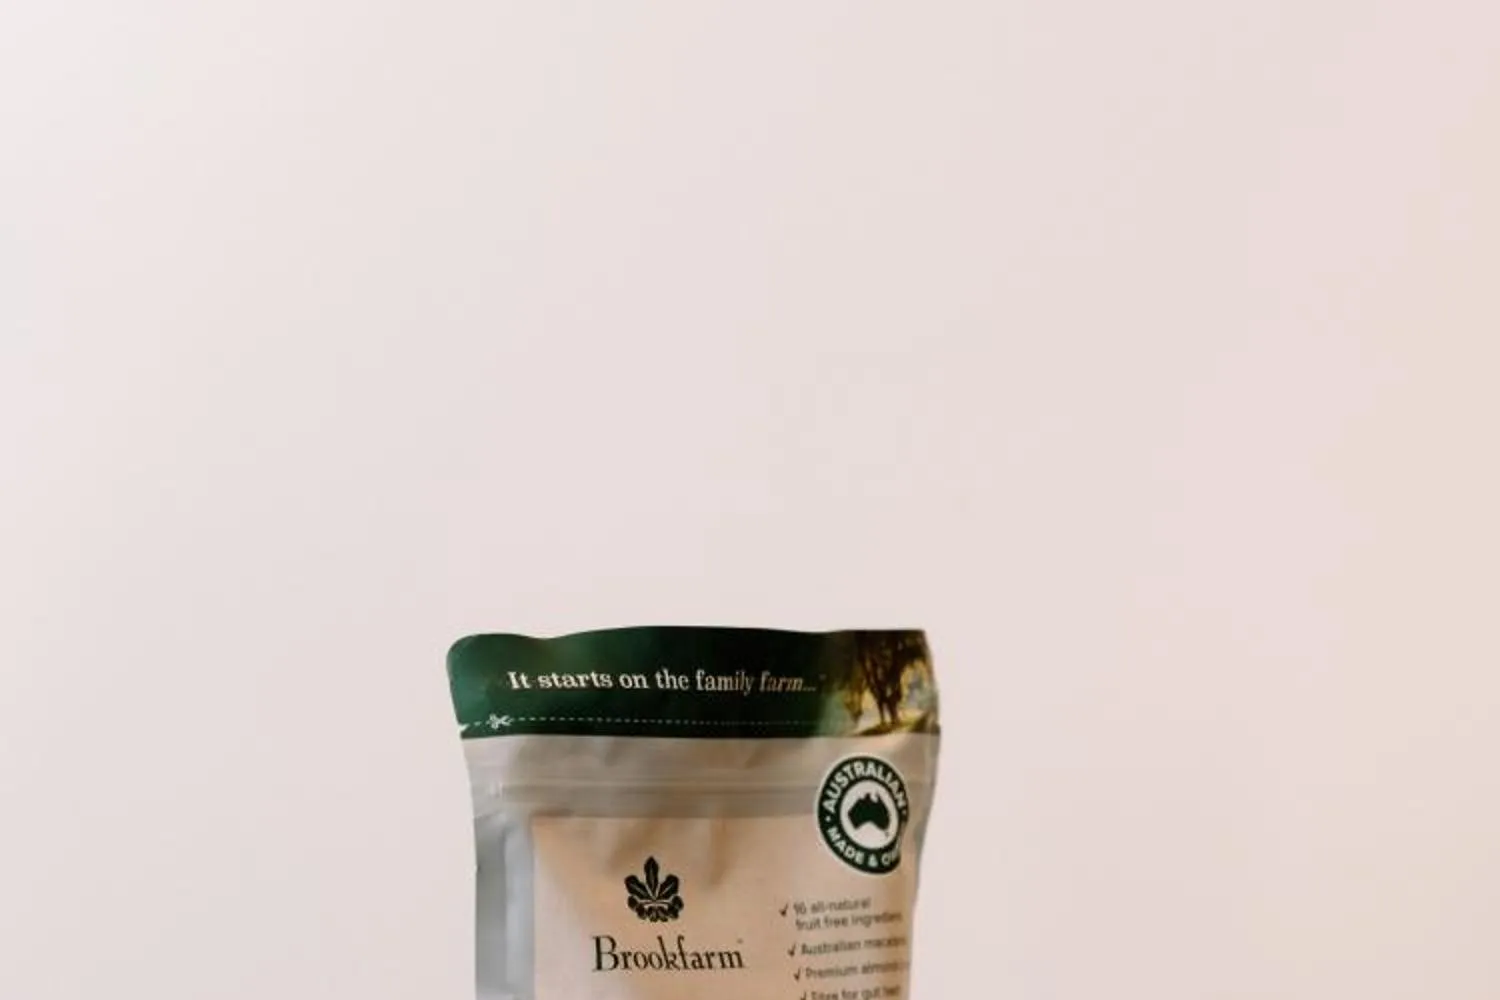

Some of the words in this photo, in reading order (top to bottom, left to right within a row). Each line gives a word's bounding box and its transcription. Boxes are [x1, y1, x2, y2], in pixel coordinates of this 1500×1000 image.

[507, 670, 531, 689] It
[538, 670, 613, 689] starts
[619, 673, 649, 689] on
[655, 668, 689, 690] the
[696, 669, 753, 696] family
[822, 761, 906, 814] AUSTRALIAN
[827, 827, 865, 865] MADE
[592, 934, 746, 973] Brookfarm
[801, 941, 861, 955] Australian
